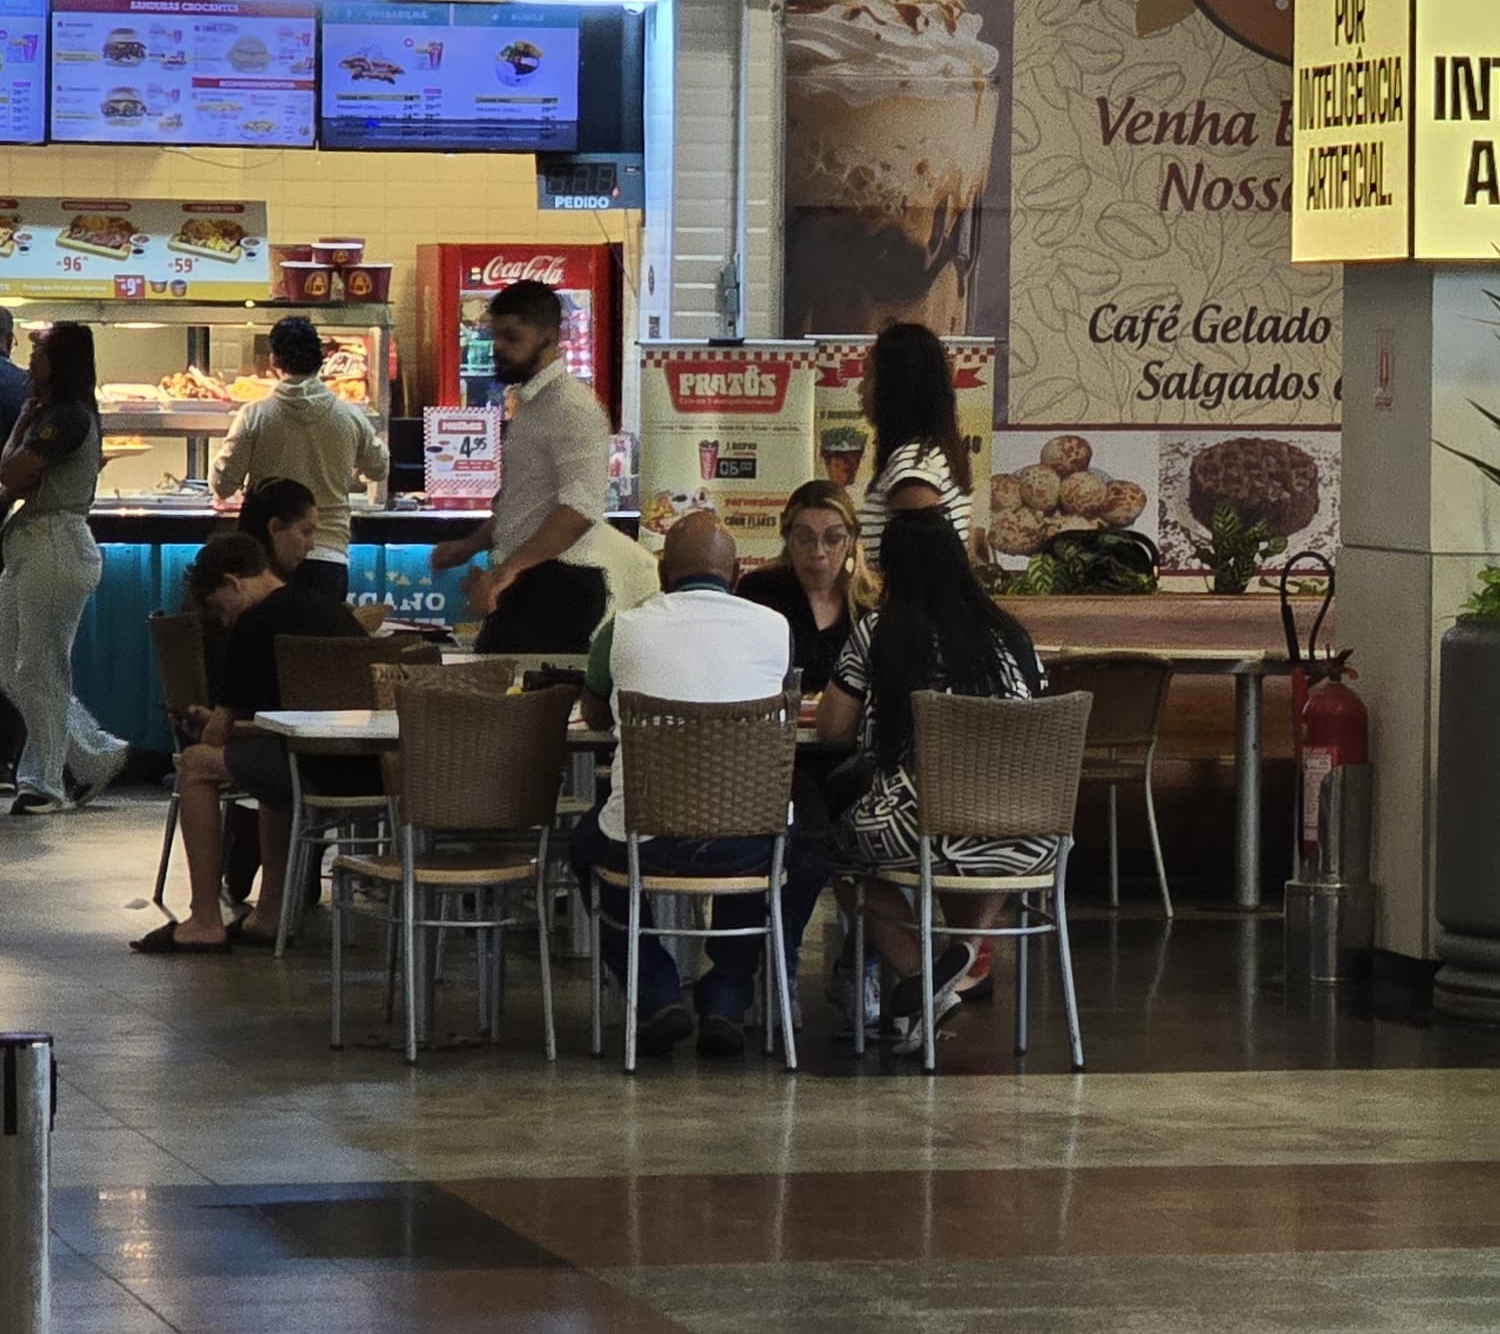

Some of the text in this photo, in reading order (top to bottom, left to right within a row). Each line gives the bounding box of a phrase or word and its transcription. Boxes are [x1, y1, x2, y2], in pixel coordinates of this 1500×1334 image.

[1299, 49, 1404, 131] INTELIGÊNCIA
[1095, 96, 1258, 147] Venha
[1306, 140, 1392, 212] ARTIFICIAL.
[554, 195, 610, 209] PEDIDO
[1088, 303, 1331, 351] Café Gelado
[1136, 361, 1322, 411] Salgados
